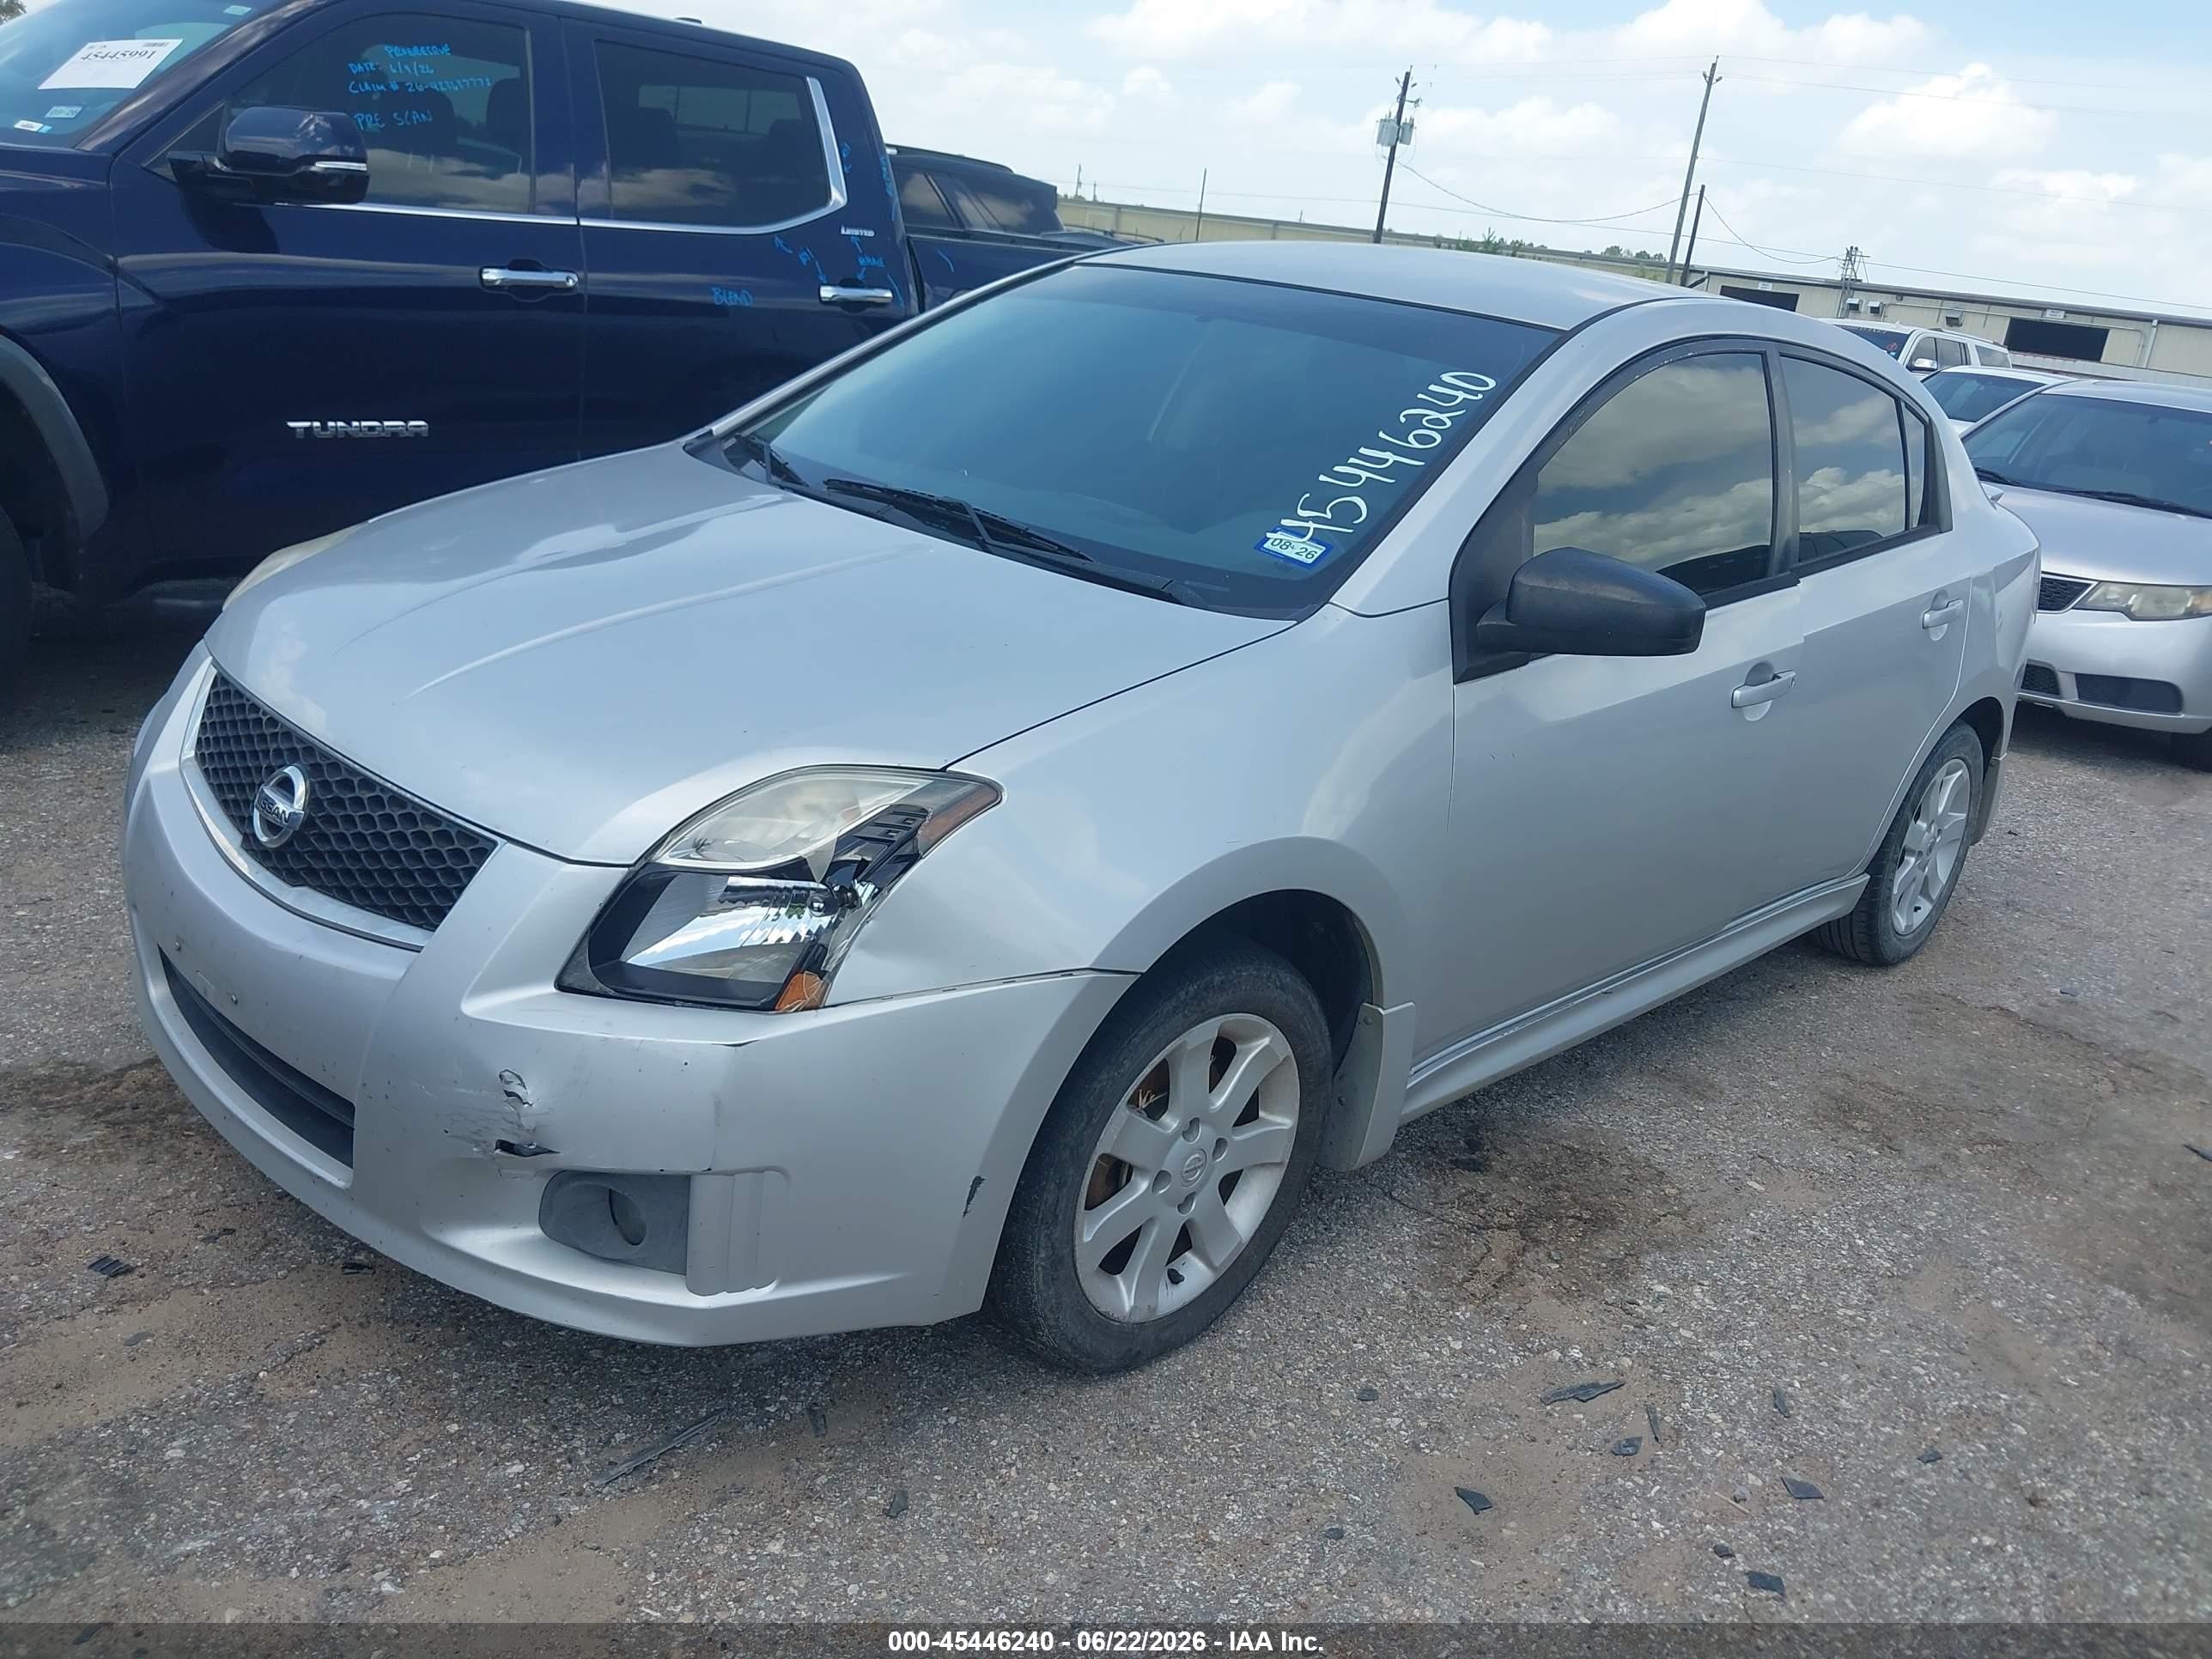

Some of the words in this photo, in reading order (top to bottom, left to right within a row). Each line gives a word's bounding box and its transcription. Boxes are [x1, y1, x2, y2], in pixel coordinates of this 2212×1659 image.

[354, 112, 386, 131] PRE
[392, 109, 434, 126] SCAN
[286, 420, 429, 439] TUNDRA
[1266, 371, 1498, 543] 45446240
